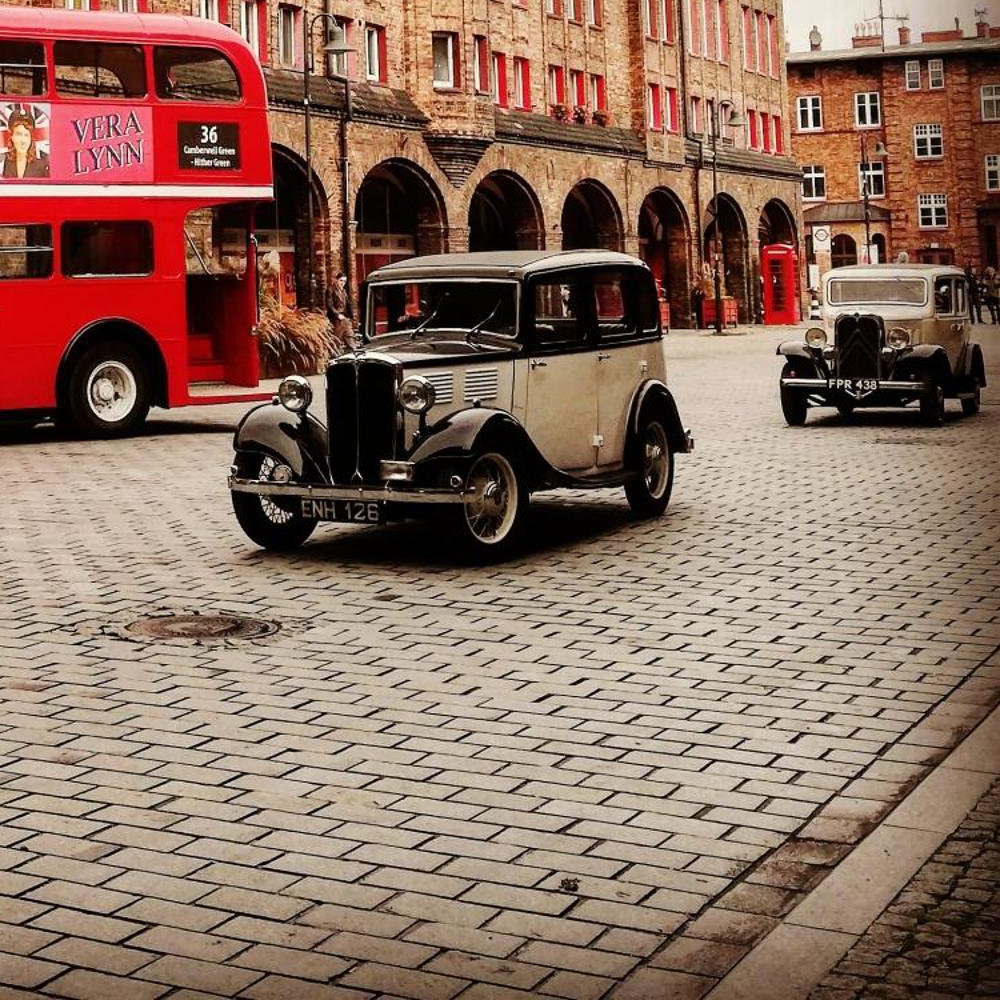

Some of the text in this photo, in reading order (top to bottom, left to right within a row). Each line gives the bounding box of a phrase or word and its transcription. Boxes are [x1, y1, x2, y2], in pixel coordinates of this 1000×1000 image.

[72, 110, 144, 145] VERA
[200, 125, 218, 144] 36
[73, 139, 144, 176] LYNN
[828, 378, 878, 391] FPR 438
[301, 500, 379, 521] ENH 126
